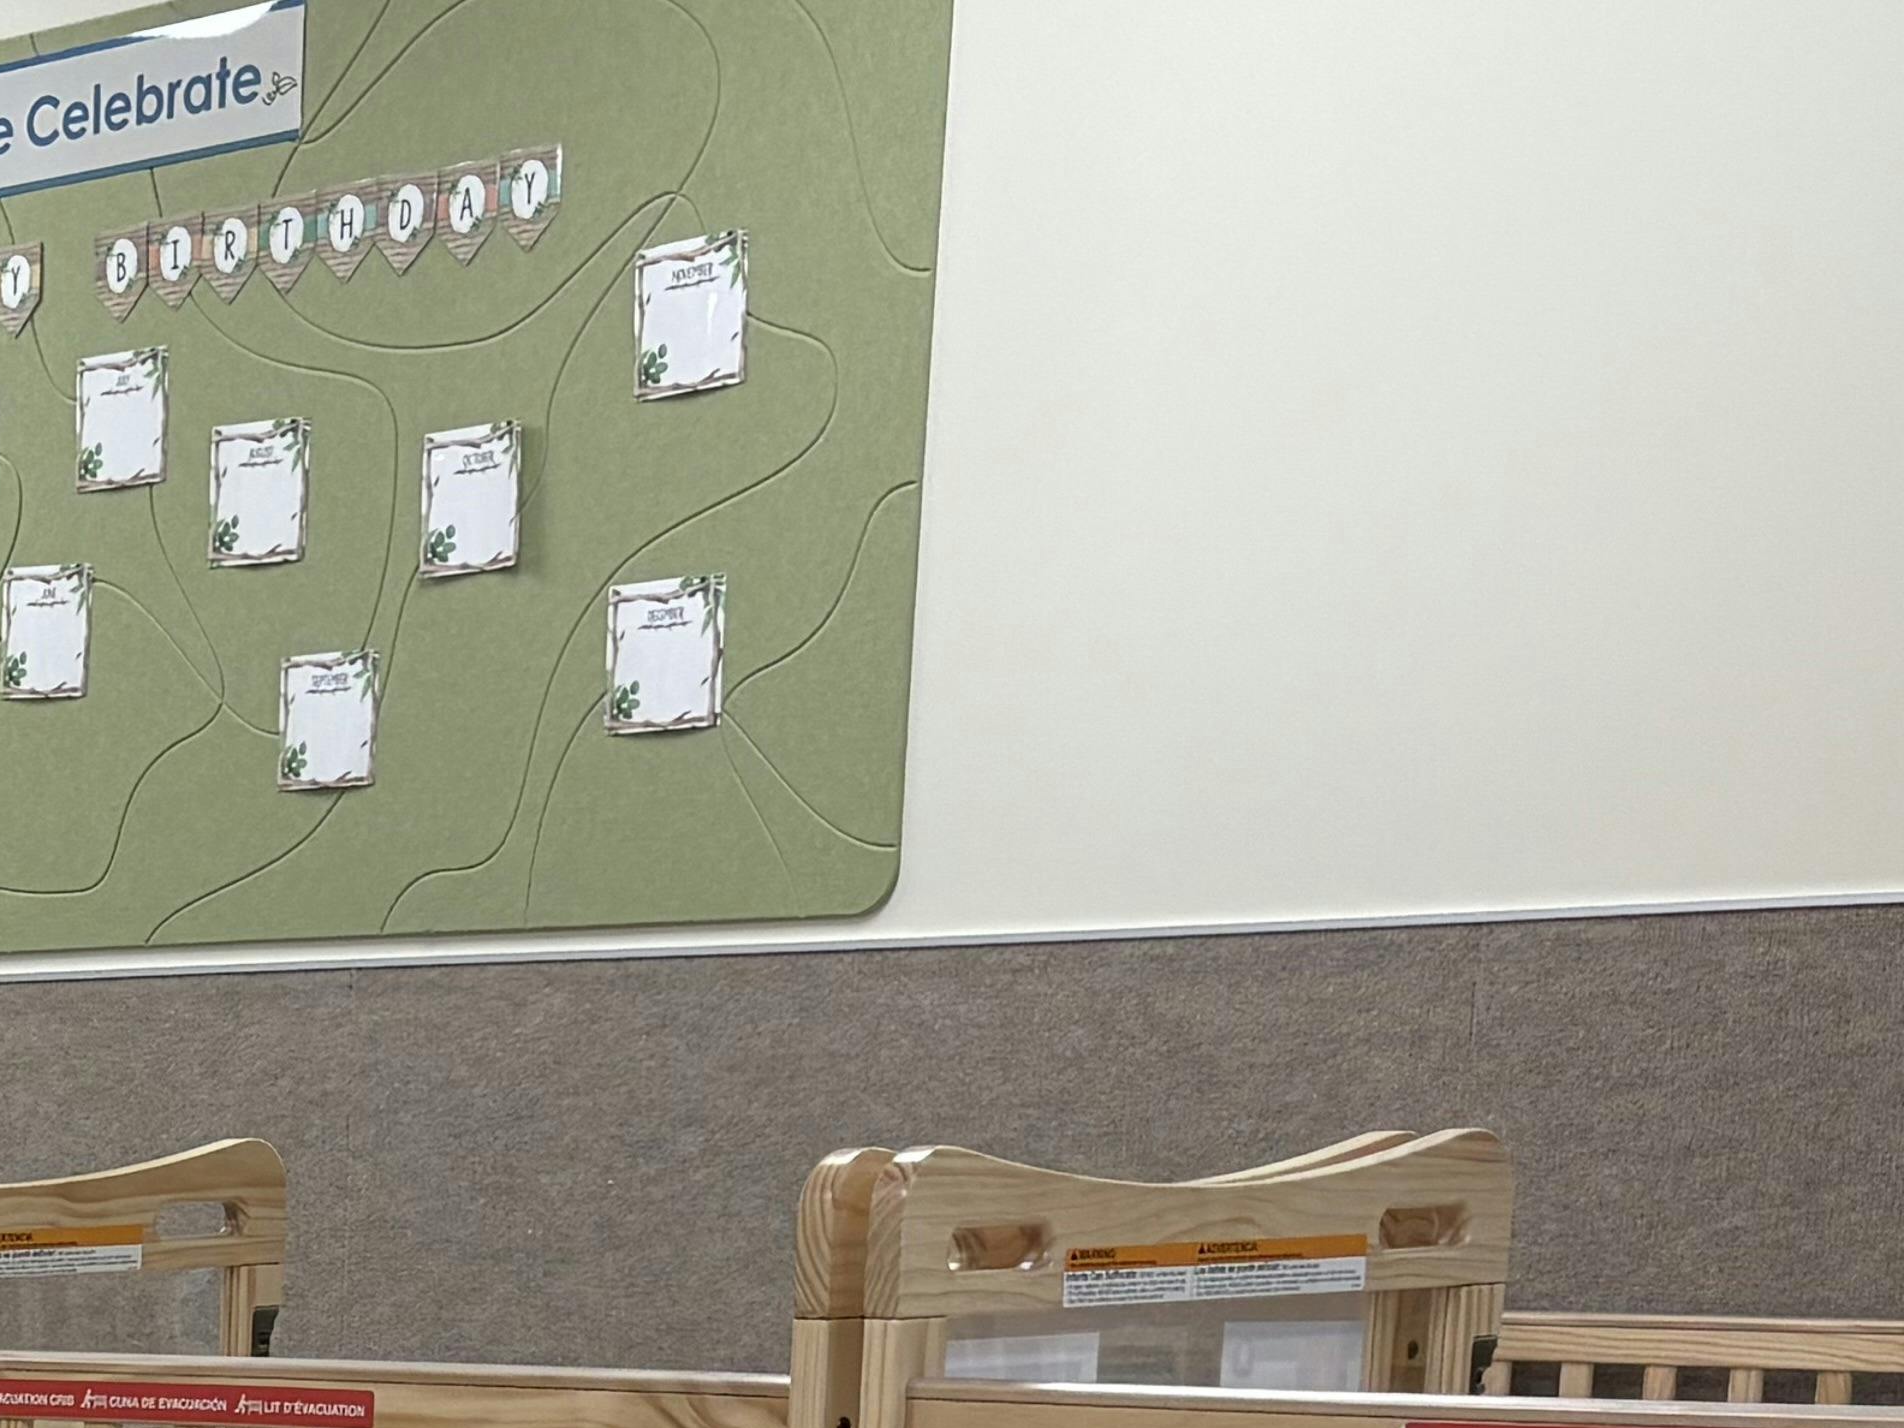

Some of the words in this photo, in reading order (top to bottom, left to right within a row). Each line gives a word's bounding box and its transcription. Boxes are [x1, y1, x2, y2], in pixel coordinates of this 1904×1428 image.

[26, 56, 263, 148] Celebrate
[116, 171, 537, 272] BIRTHDAY
[671, 262, 714, 283] NOVEMBER
[49, 1392, 75, 1407] CRIB
[109, 1395, 139, 1410] CUNA
[141, 1396, 156, 1410] DE
[158, 1396, 227, 1412] EVACUACIÓN
[263, 1400, 281, 1415] LIT
[283, 1399, 365, 1418] D'ÉVACUATION
